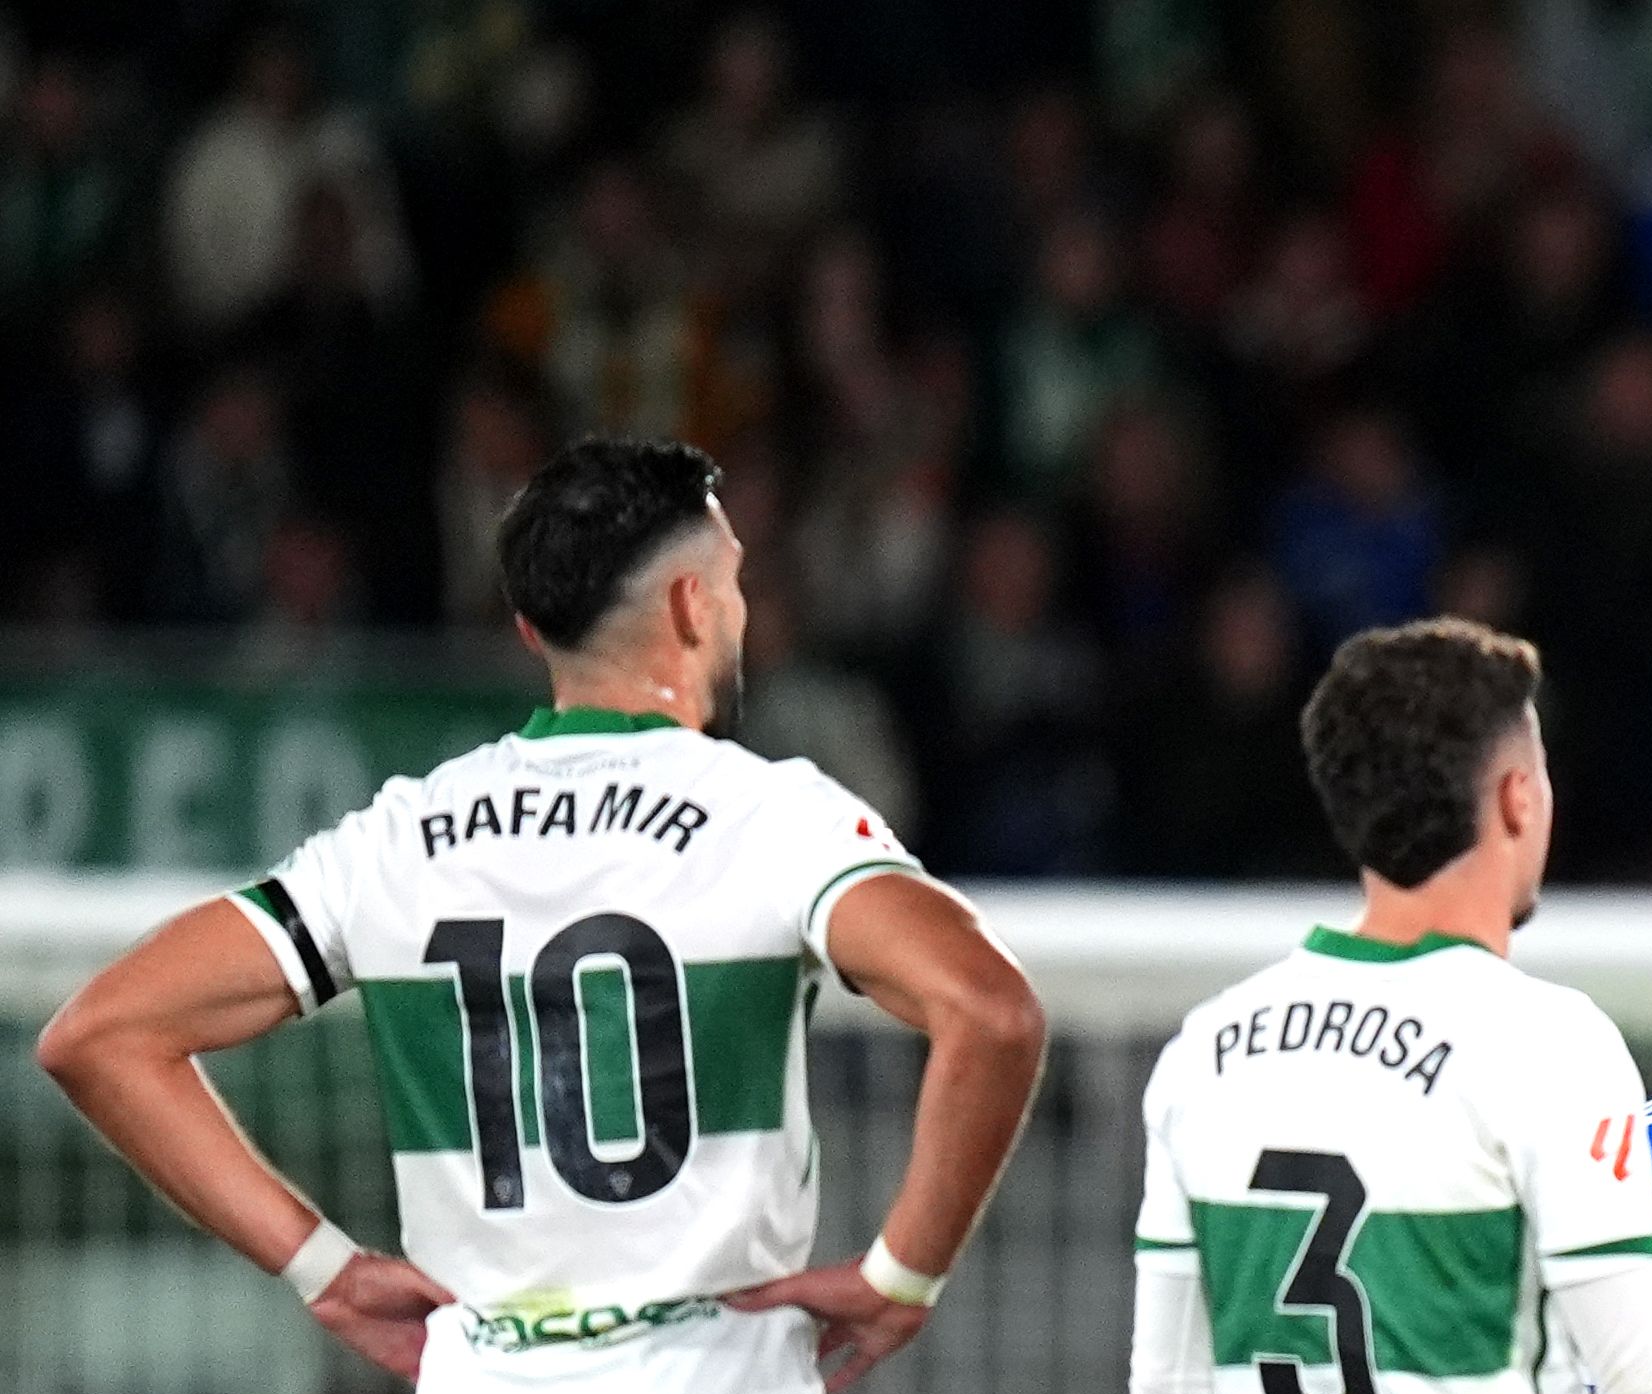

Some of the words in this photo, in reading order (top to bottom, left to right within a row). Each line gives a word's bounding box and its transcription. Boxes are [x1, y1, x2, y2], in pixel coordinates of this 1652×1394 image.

[420, 788, 577, 859] RAFA
[589, 783, 710, 854] MIR
[422, 912, 697, 1211] 10
[1215, 1001, 1453, 1096] PEDROSA
